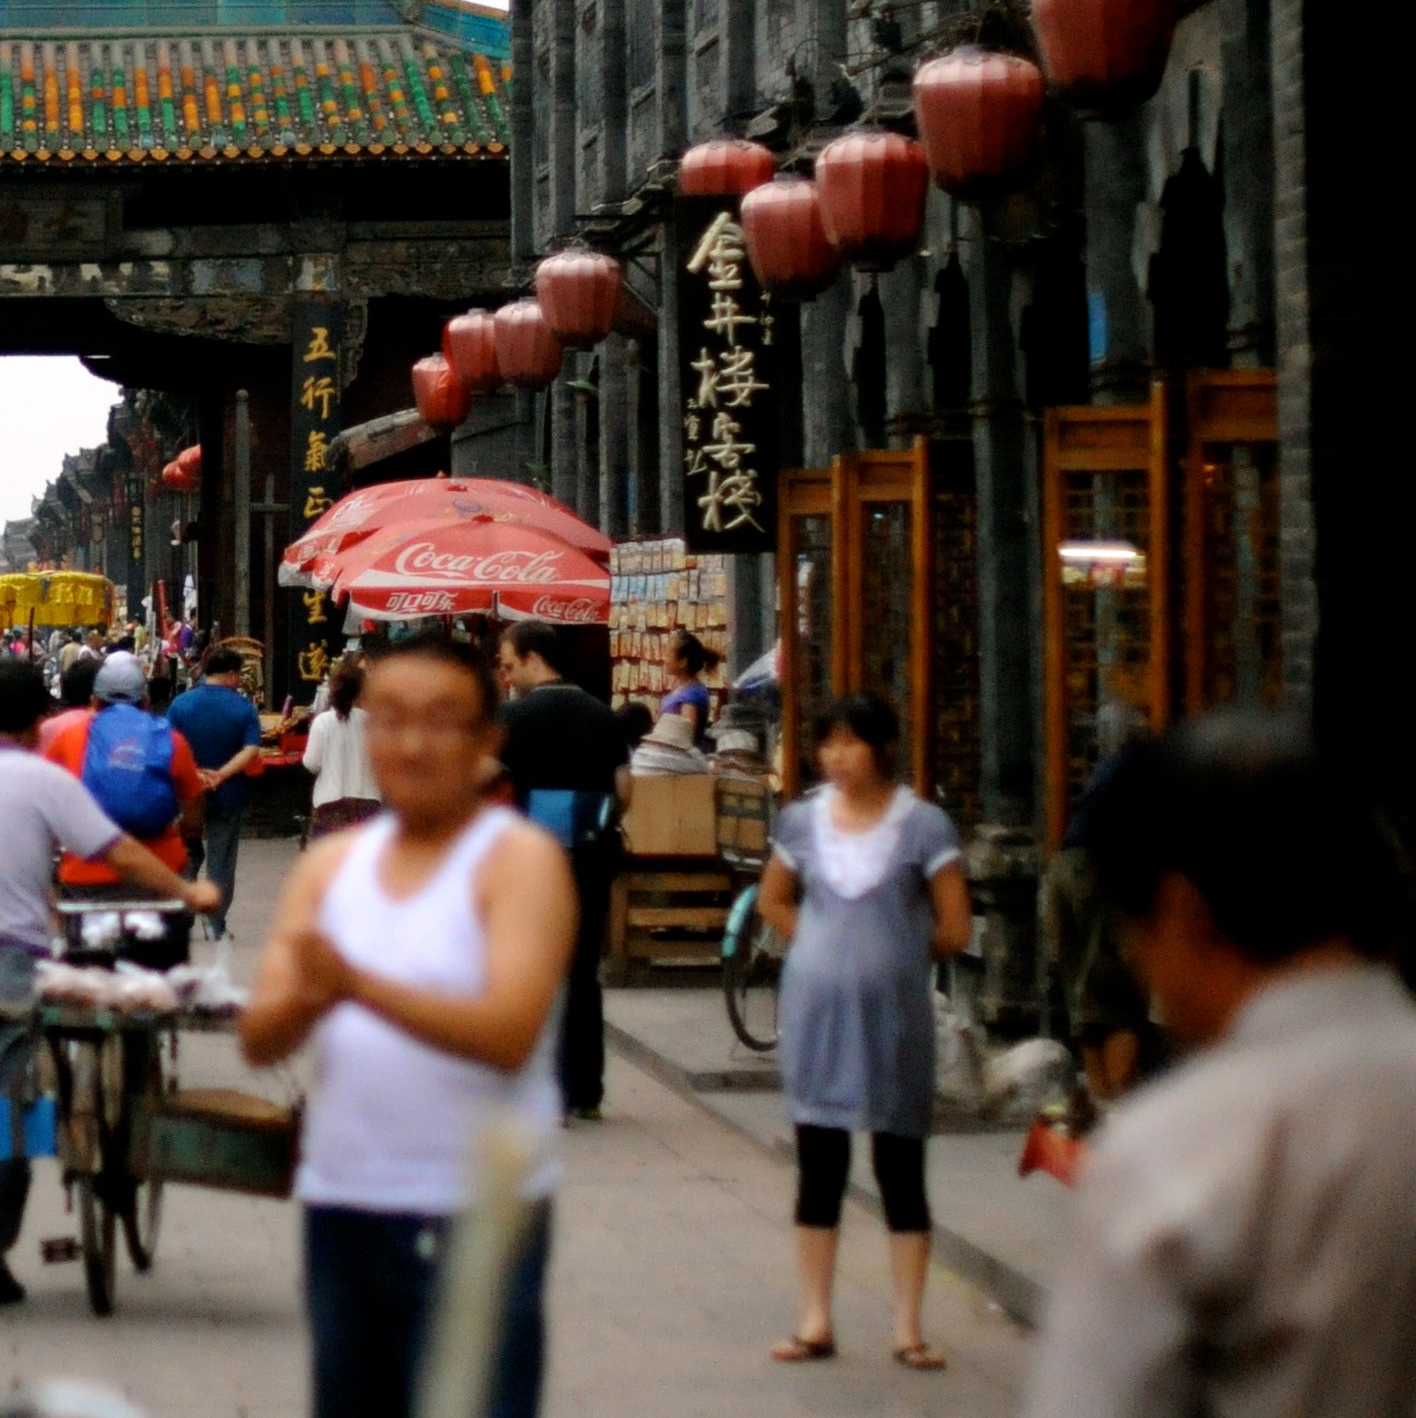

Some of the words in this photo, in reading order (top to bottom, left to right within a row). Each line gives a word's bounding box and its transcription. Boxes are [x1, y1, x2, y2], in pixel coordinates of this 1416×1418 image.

[395, 542, 566, 582] Coca-Cola
[385, 590, 456, 612] 可口可乐
